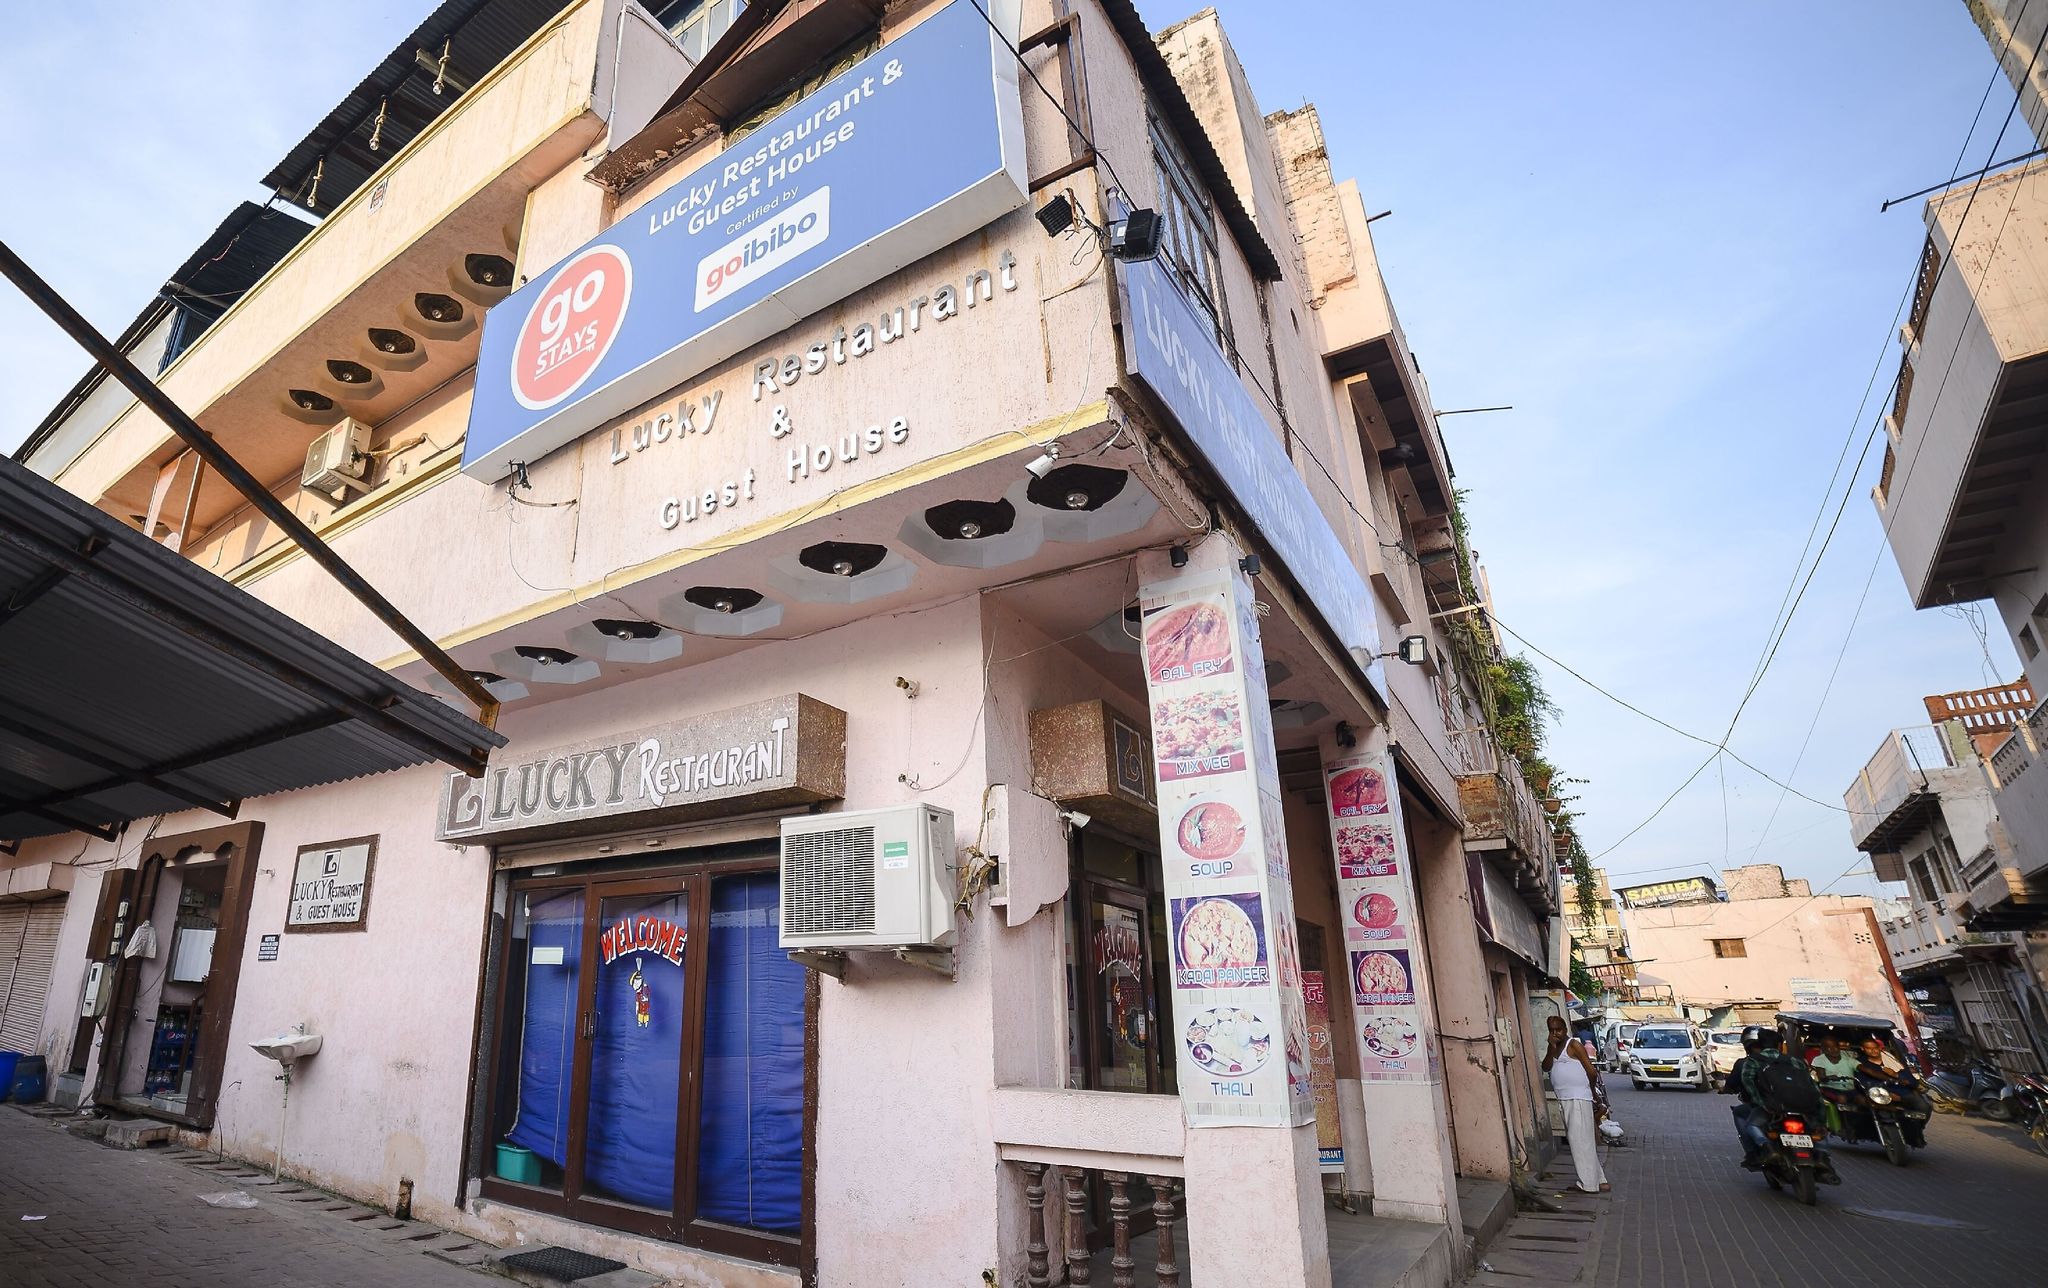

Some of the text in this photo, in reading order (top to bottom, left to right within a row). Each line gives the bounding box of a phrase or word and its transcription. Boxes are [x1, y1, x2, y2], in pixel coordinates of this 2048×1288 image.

[650, 59, 904, 236] Lucky Restaurant &
[688, 120, 855, 235] Guest House
[727, 186, 799, 236] Certified by
[706, 211, 818, 296] goibibo
[540, 269, 606, 352] go
[535, 320, 599, 376] STAYS
[611, 248, 1018, 466] Lucky Restaurant
[1141, 285, 1212, 424] LUCKY
[769, 404, 794, 440] &
[658, 415, 910, 531] Guest House
[1161, 659, 1222, 681] DAL FRY
[489, 743, 638, 824] LUCKY
[638, 717, 791, 808] RESTAURANT
[1177, 755, 1230, 775] MIX VEG
[1341, 803, 1381, 817] DAL FRY
[1190, 861, 1233, 877] SOUP
[294, 879, 363, 902] LUCKY RESTAURANT
[1626, 879, 1703, 900] SAHIBA
[296, 902, 357, 920] & GUEST HOUSE
[601, 914, 689, 968] WELCOME
[1363, 929, 1392, 939] SOUP
[1094, 925, 1142, 983] WELCOME
[1177, 968, 1214, 985] KADAI
[1217, 967, 1270, 982] PANEER
[1314, 1032, 1326, 1043] 75
[1380, 1061, 1408, 1070] THALI
[1210, 1082, 1254, 1097] THALI
